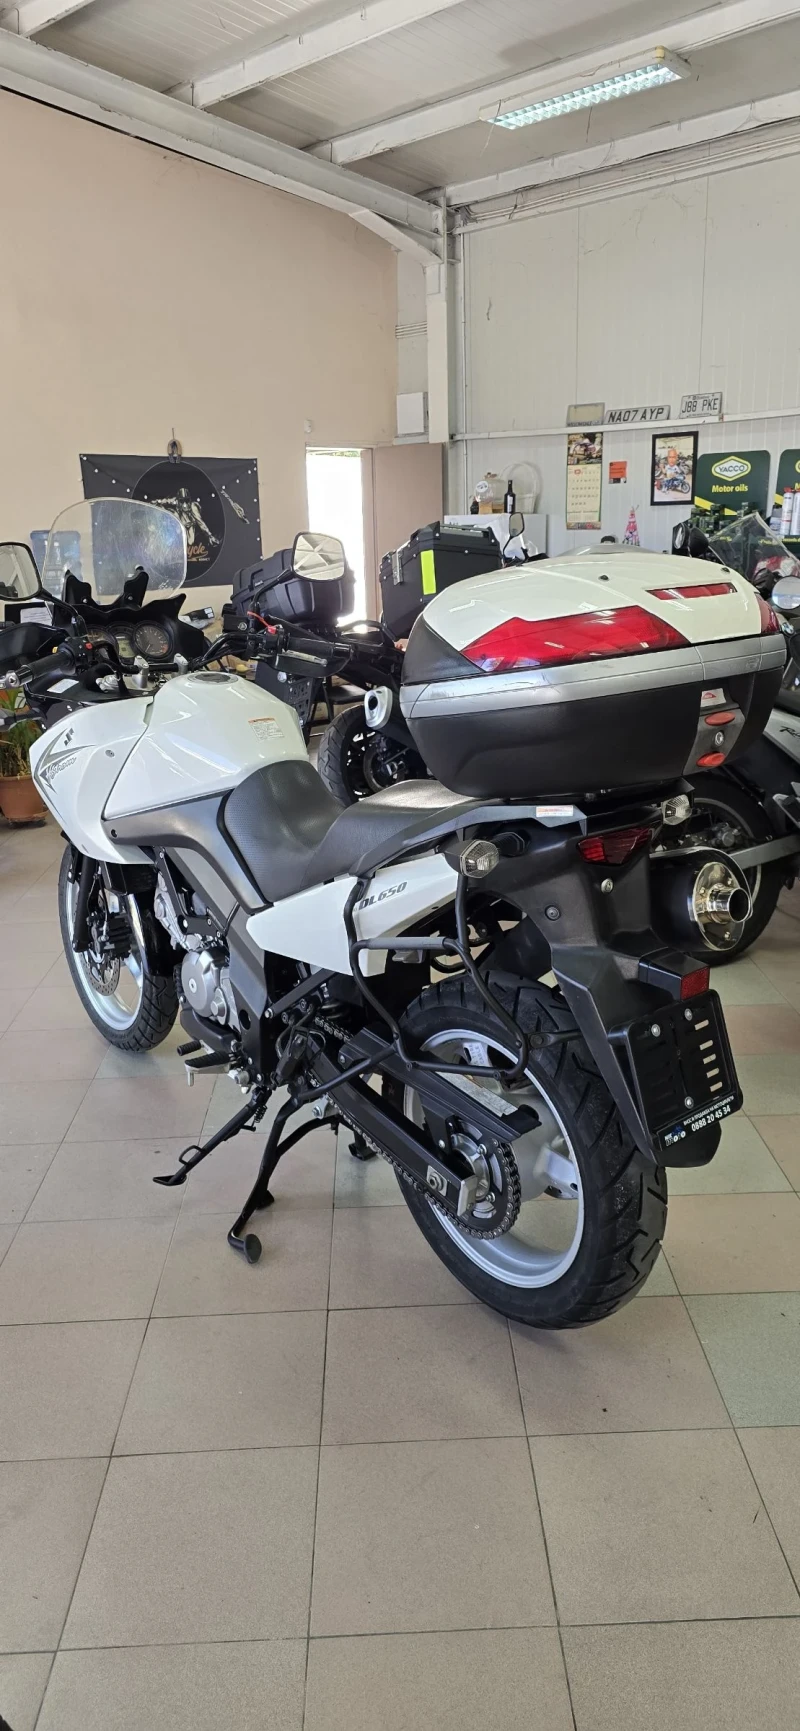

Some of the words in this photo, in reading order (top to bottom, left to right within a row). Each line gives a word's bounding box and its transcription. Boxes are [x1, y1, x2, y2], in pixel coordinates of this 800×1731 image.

[682, 401, 698, 413] J88
[702, 398, 719, 411] PKE
[607, 409, 639, 423] NA07
[640, 407, 665, 421] AYP
[718, 464, 745, 473] YACCO
[711, 485, 734, 493] Motor
[735, 483, 749, 492] oils
[706, 1113, 715, 1124] 20
[715, 1109, 723, 1119] 45
[722, 1104, 731, 1115] 34
